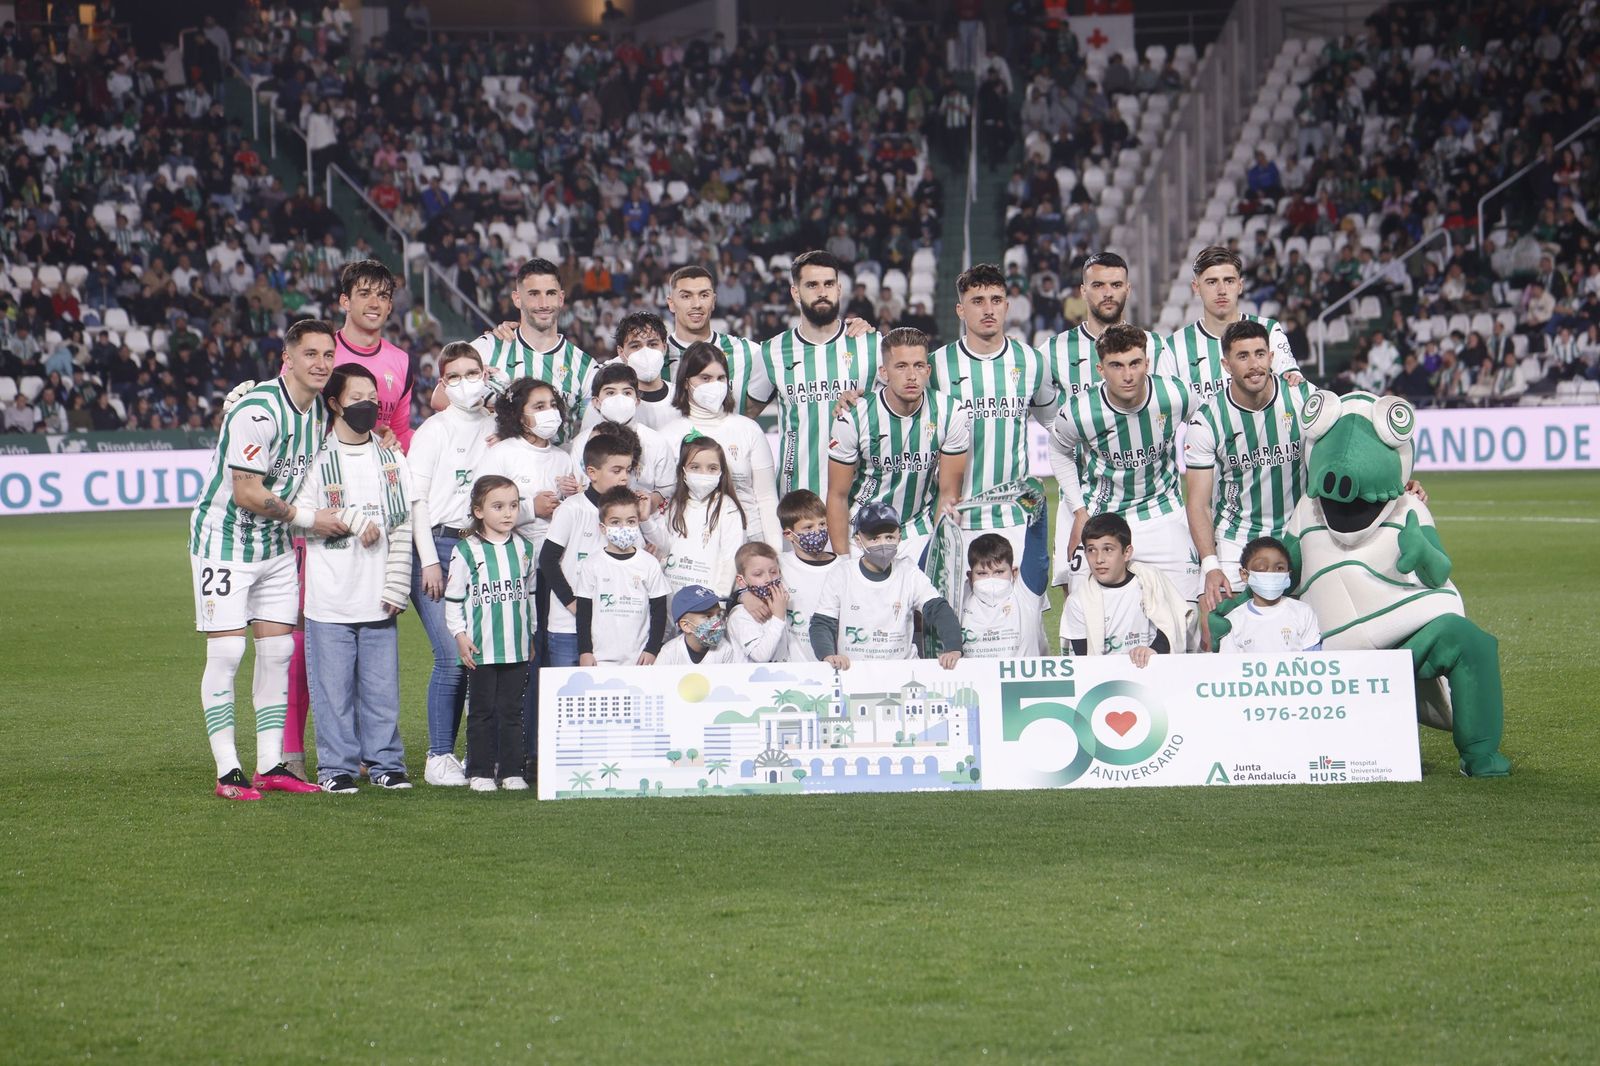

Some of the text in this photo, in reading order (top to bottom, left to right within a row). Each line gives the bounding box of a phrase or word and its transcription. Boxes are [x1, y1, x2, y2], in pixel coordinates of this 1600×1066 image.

[787, 380, 858, 395] BAHRAIN
[966, 397, 1024, 409] AHRAIN
[968, 409, 1022, 419] CTORIOUS
[1229, 441, 1300, 464] BAHRAIN
[1545, 425, 1590, 461] DE
[872, 452, 938, 465] BAHRAIN
[84, 468, 204, 506] CUID
[202, 567, 231, 596] 23
[1000, 659, 1074, 678] HURS
[1242, 656, 1341, 677] 50 AÑOS
[1196, 678, 1390, 698] CUIDANDO DE TI
[1243, 706, 1346, 721] 1976-2026
[1001, 680, 1168, 787] 50
[1090, 734, 1184, 782] ANIVERSARIO
[1233, 763, 1261, 772] Junta
[1233, 771, 1297, 781] de Andalucía
[1310, 772, 1347, 782] HURS
